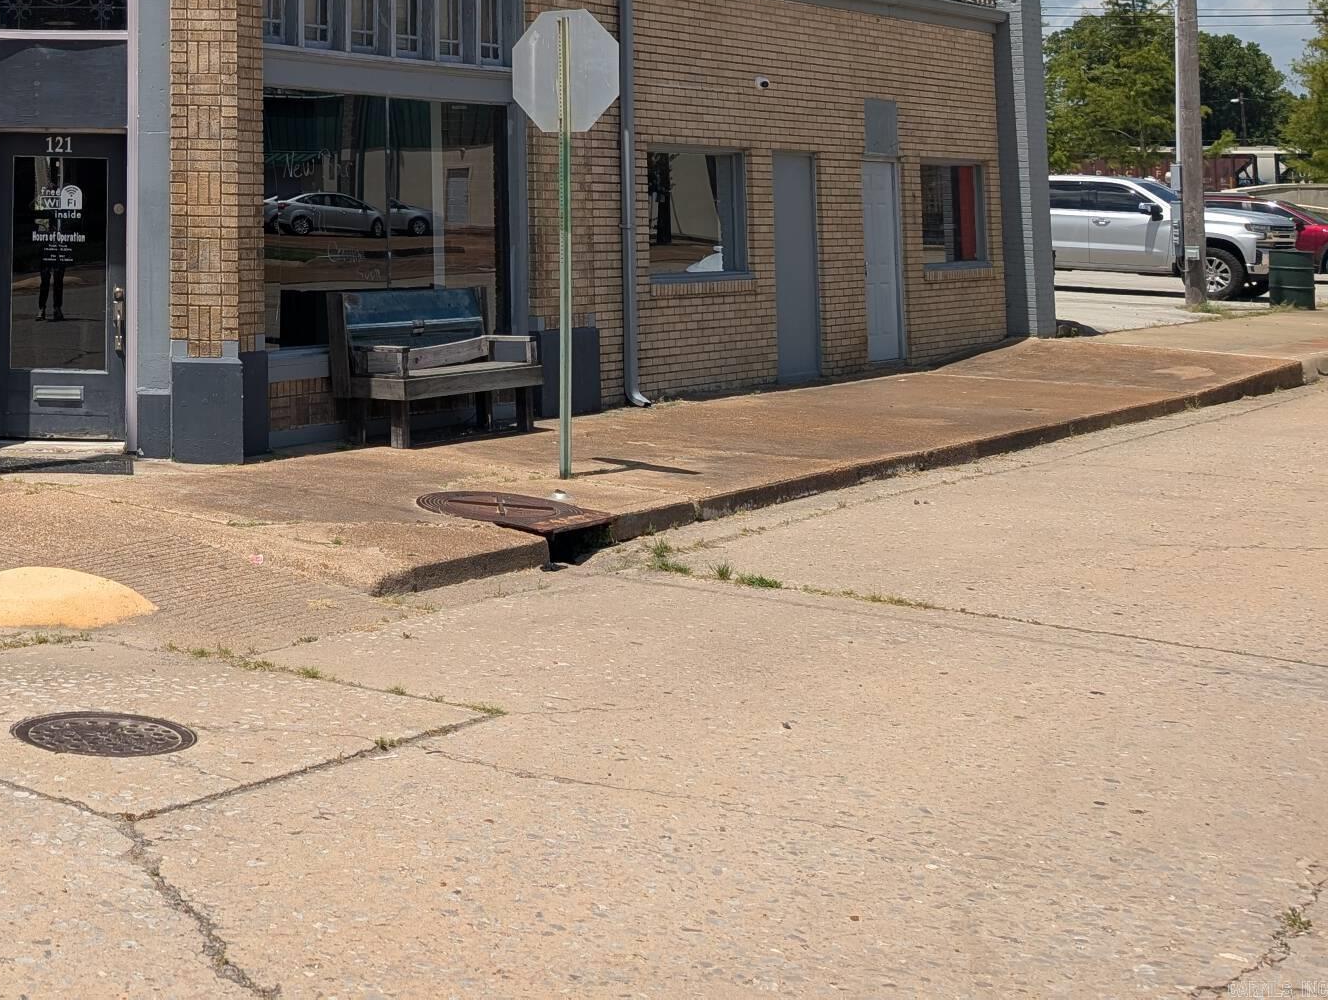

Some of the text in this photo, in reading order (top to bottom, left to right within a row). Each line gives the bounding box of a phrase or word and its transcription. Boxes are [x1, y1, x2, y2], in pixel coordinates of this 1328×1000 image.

[45, 136, 73, 153] 121
[283, 151, 315, 179] New
[41, 186, 61, 196] free
[54, 209, 82, 219] inside
[32, 231, 86, 244] Hours of Operation
